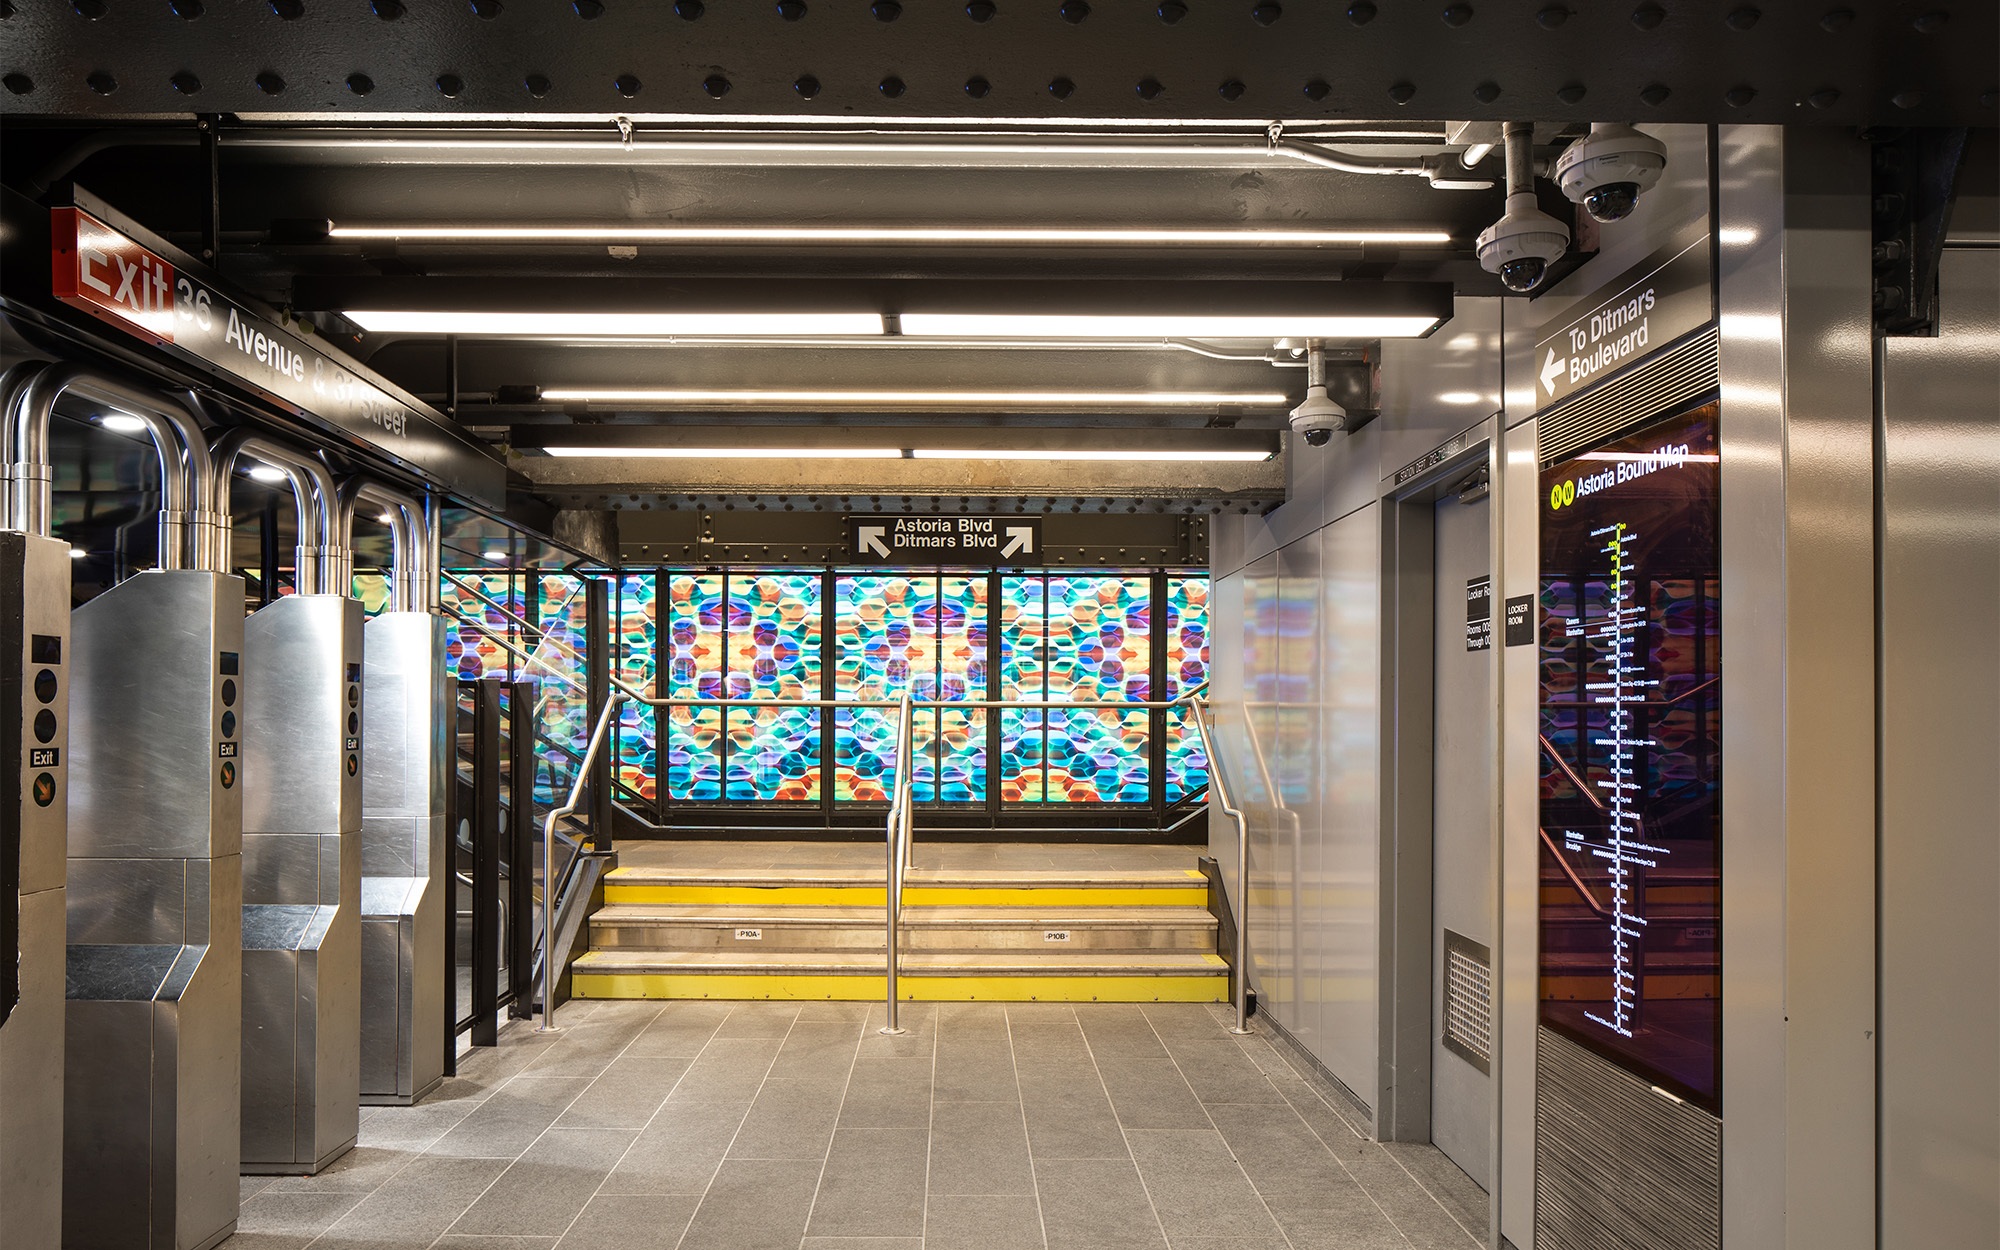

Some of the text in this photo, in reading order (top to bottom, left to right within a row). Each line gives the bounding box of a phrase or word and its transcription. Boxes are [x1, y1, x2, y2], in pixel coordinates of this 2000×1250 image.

[1569, 288, 1655, 354] To Ditmars
[79, 218, 168, 320] Exit
[177, 278, 212, 331] 36
[225, 307, 304, 382] Avenue
[313, 357, 326, 395] &
[360, 386, 407, 439] Street
[1570, 317, 1648, 384] Boulevard
[1576, 468, 1615, 498] Astoria
[1617, 449, 1657, 484] Bound
[1660, 443, 1689, 469] Map
[894, 518, 993, 532] Astoria Blvd
[894, 533, 997, 547] Ditmars Blvd
[1468, 588, 1483, 600] Locker
[1508, 604, 1529, 615] LOCKER
[1508, 616, 1523, 626] ROOM
[1467, 625, 1481, 635] Rooms
[221, 744, 234, 756] Exit
[347, 739, 357, 750] Exit
[33, 751, 54, 765] Exit
